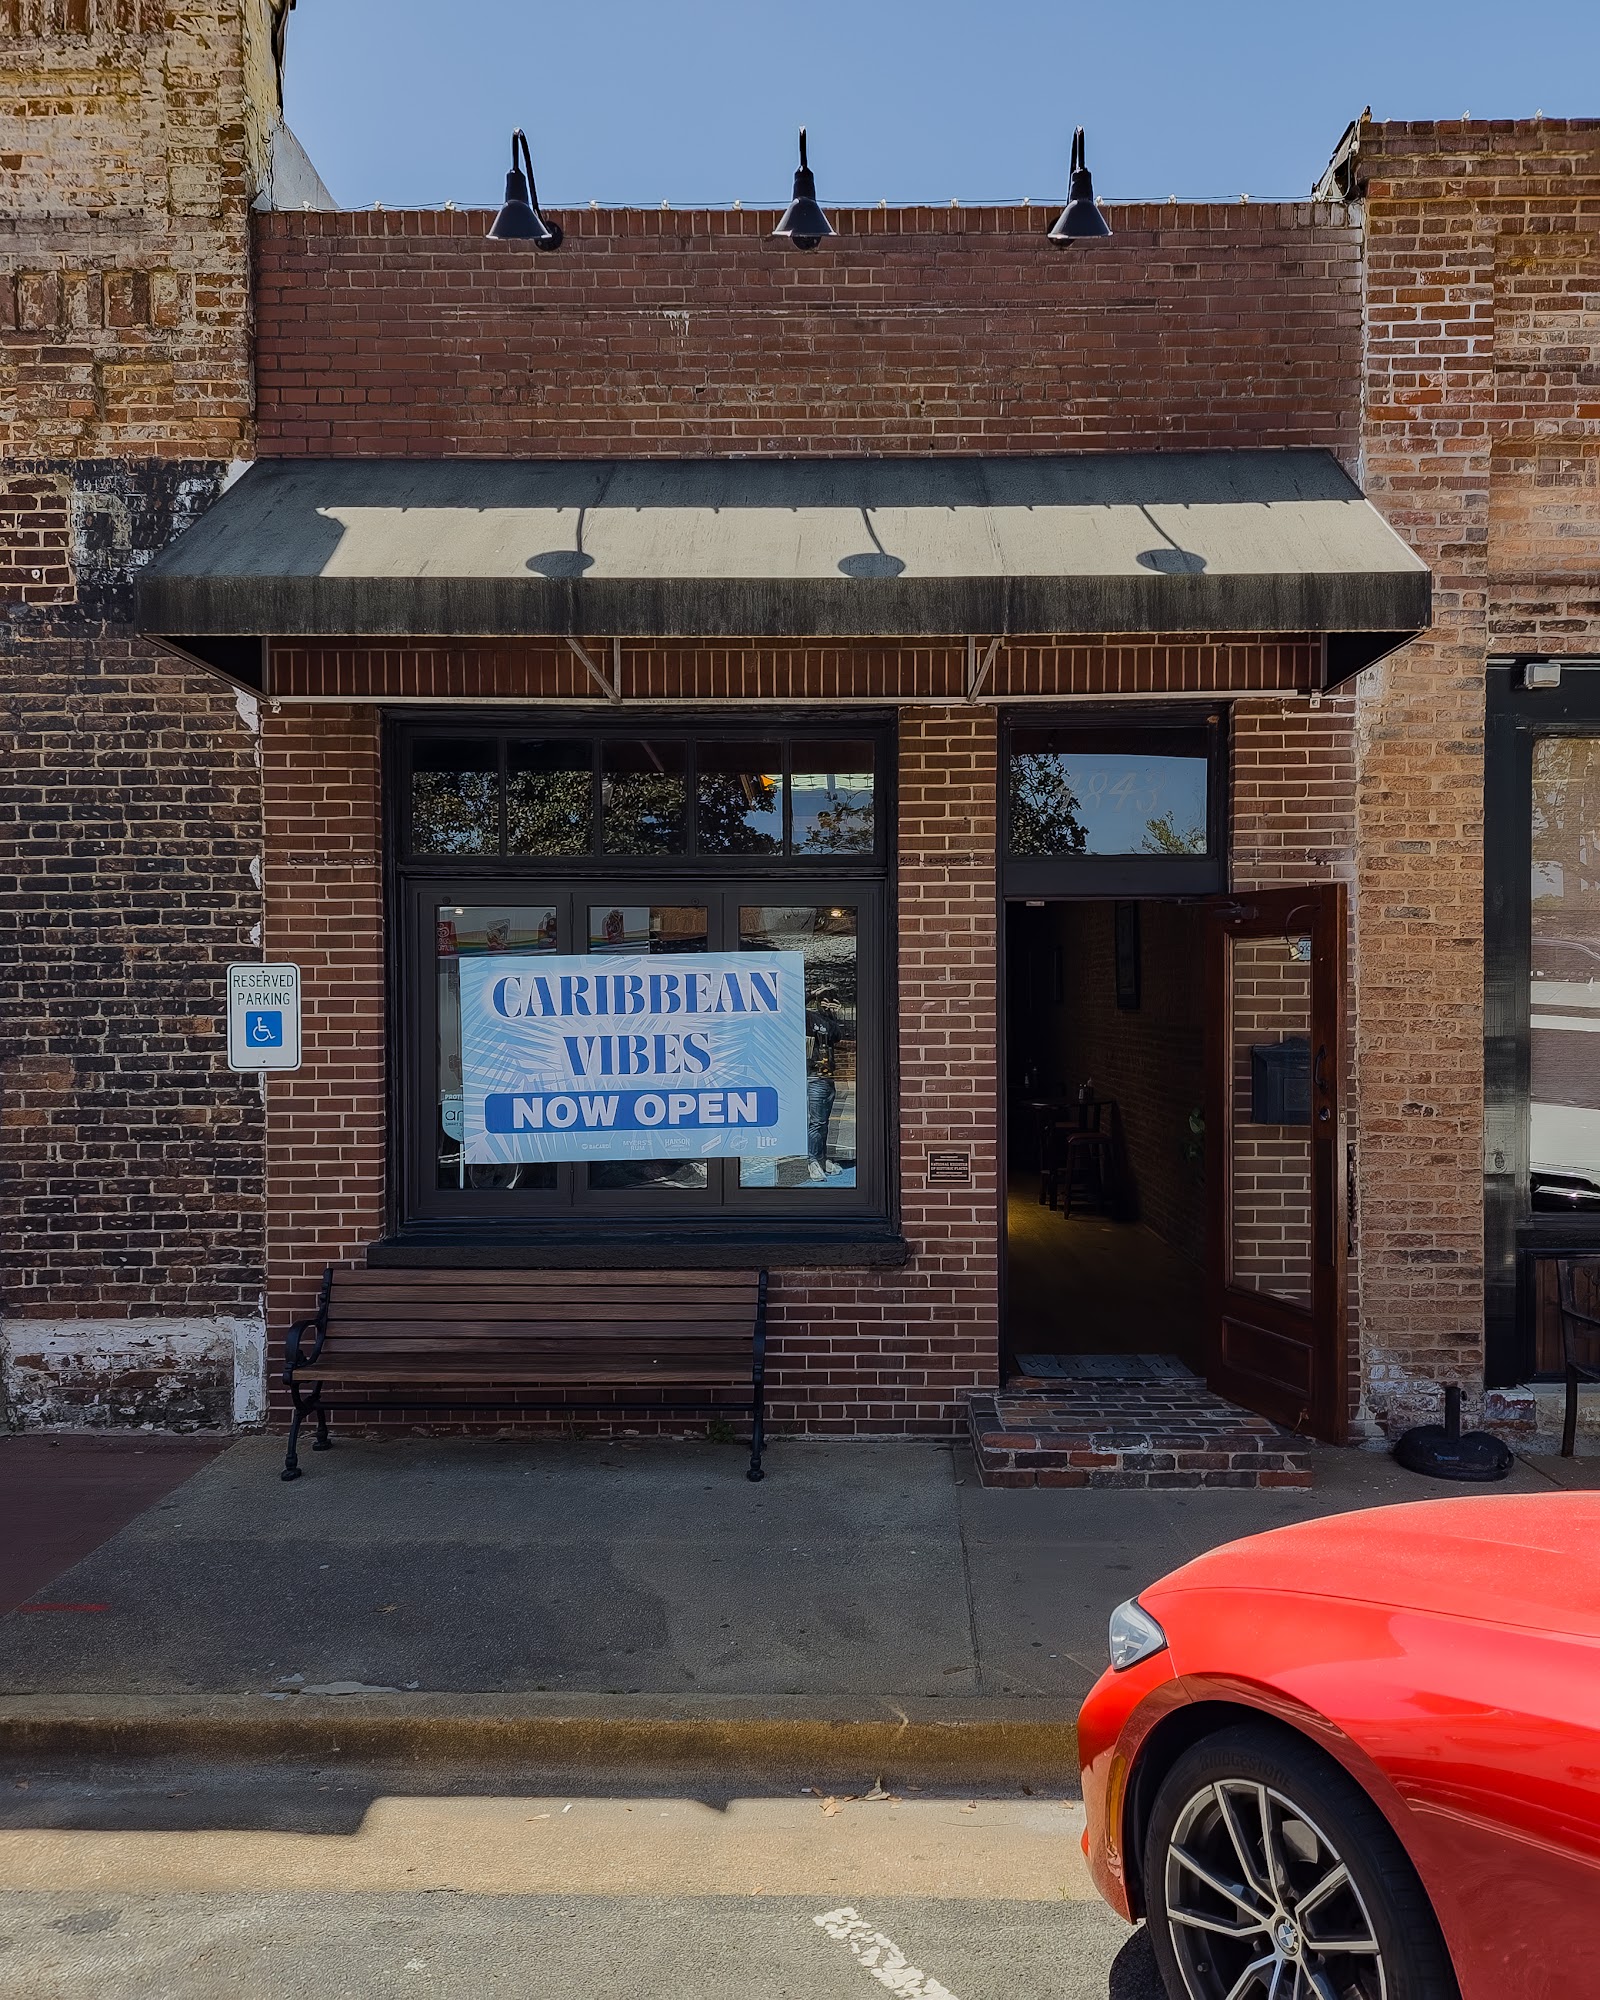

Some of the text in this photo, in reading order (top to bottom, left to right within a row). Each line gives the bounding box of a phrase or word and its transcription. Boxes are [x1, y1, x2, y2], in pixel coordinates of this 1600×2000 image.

[233, 974, 294, 988] RESERVED
[237, 992, 290, 1006] PARKING
[491, 970, 781, 1019] CARIBBEAN
[563, 1032, 712, 1077] VIBES
[512, 1091, 758, 1130] NOW OPEN
[664, 1138, 691, 1147] HANSON
[756, 1135, 778, 1149] Lite
